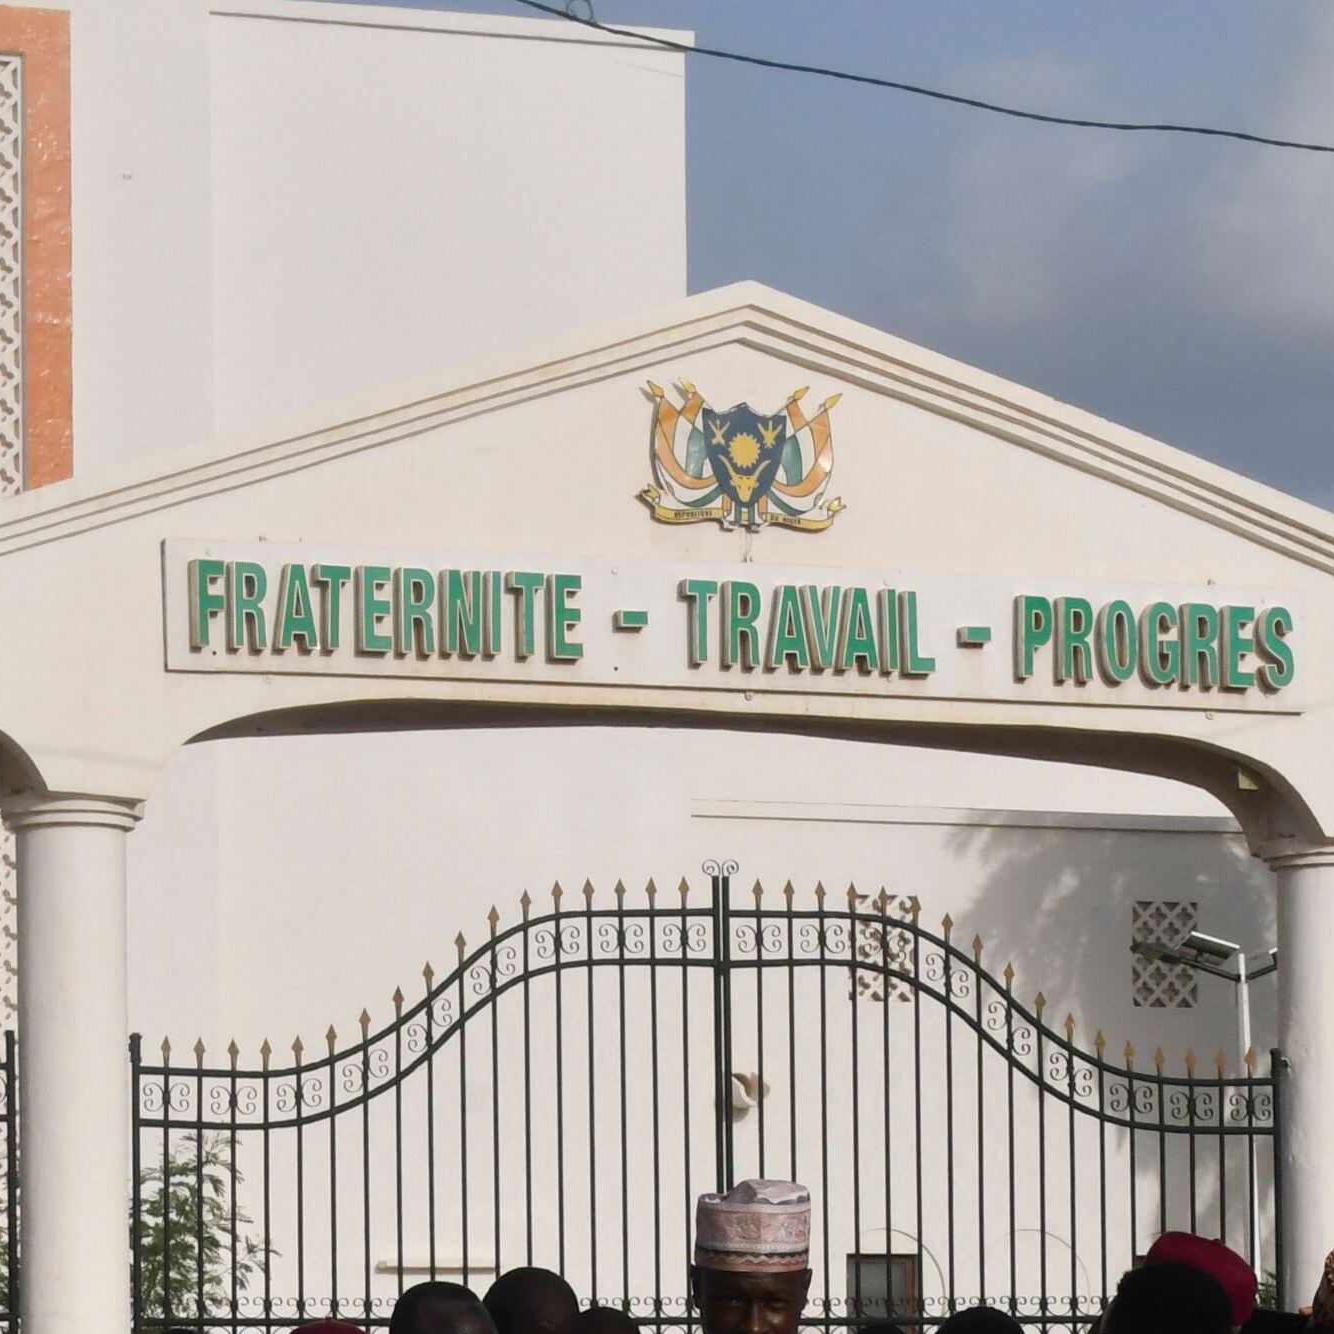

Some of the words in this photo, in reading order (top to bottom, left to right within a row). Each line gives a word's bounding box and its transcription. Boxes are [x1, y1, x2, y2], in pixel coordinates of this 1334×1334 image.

[188, 558, 584, 661] FRATERNITE
[677, 577, 937, 677] TRAVAIL
[1013, 593, 1296, 696] PROGRES
